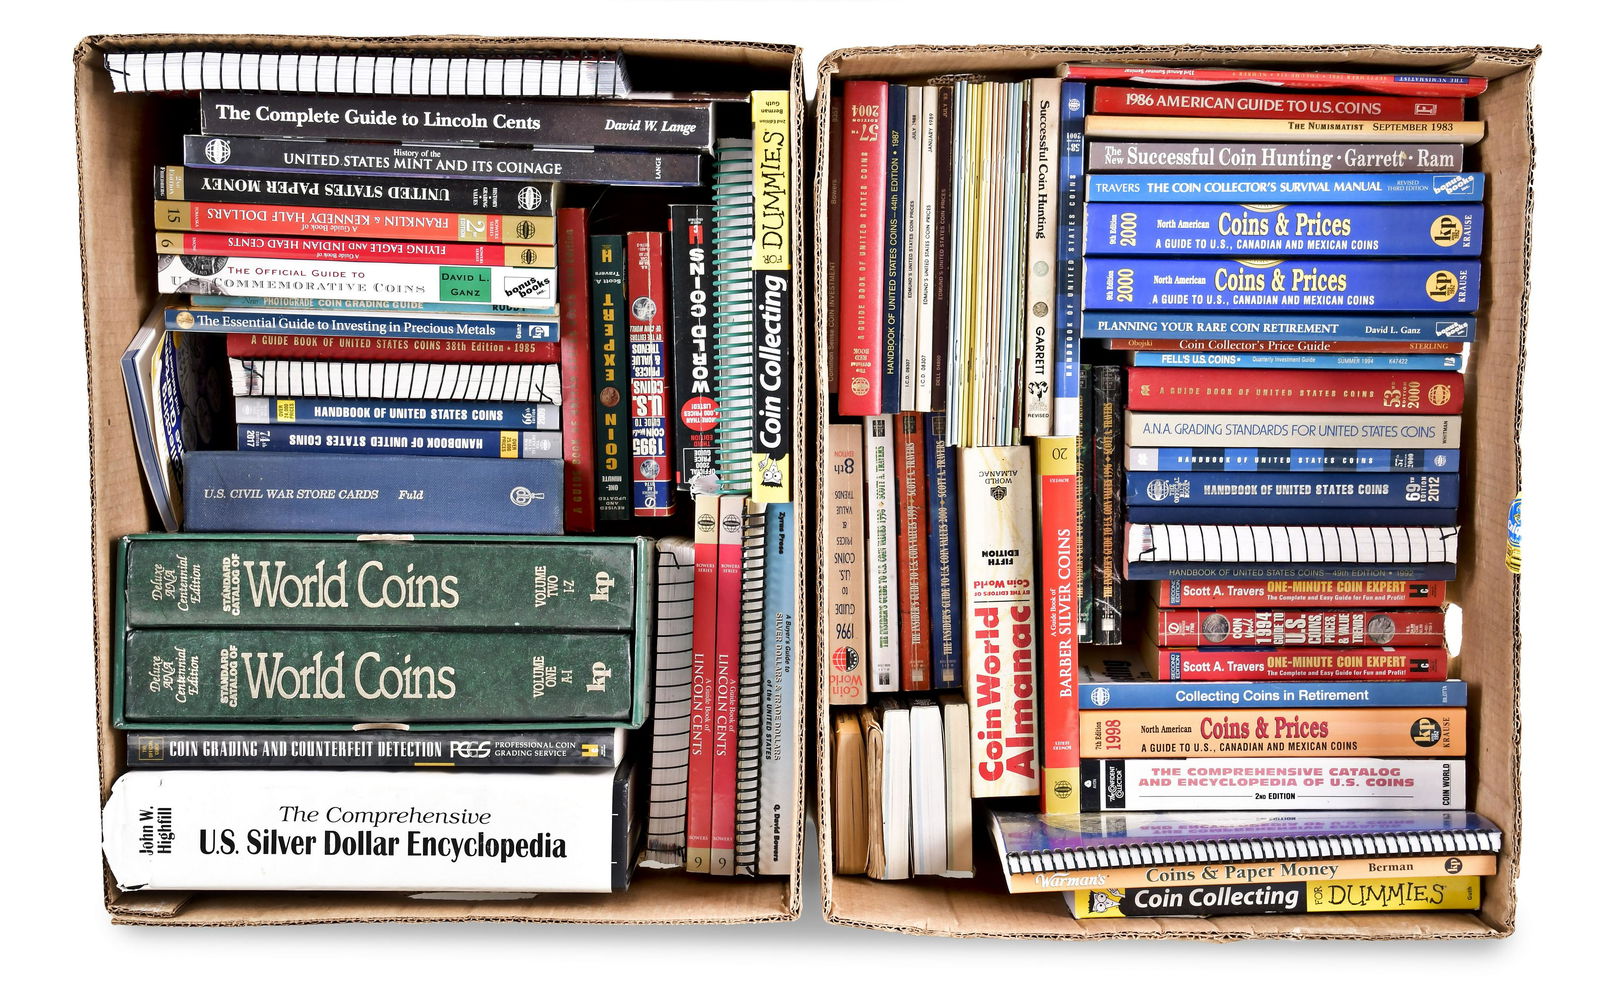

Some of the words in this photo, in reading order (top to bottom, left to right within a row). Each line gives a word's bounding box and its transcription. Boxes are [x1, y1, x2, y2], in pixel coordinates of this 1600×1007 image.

[1126, 93, 1154, 106] 1986
[1157, 95, 1234, 110] AMERICAN
[1237, 96, 1284, 112] GUIDE
[1287, 100, 1308, 112] TO
[216, 104, 251, 120] The
[256, 105, 340, 127] Complete
[344, 109, 397, 126] Guide
[402, 113, 419, 126] to
[424, 112, 488, 128] Lincoln
[494, 114, 540, 130] Cents
[604, 119, 641, 132] David
[644, 121, 658, 132] W.
[661, 121, 696, 135] Lange
[1040, 100, 1050, 160] Successful
[284, 152, 340, 166] UNITED
[344, 155, 390, 169] STATES
[394, 157, 432, 170] MINT
[436, 160, 468, 172] AND
[472, 161, 492, 172] ITS
[496, 162, 562, 174] COINAGE
[394, 148, 419, 159] History
[420, 149, 428, 158] of
[430, 150, 440, 158] the
[1127, 146, 1214, 166] Successful
[1219, 148, 1256, 166] Coin
[1261, 148, 1334, 170] Hunting
[1344, 149, 1405, 167] Garrett
[1417, 149, 1454, 167] Ram
[202, 177, 261, 192] MONEY
[266, 180, 320, 196] PAPER
[1038, 164, 1048, 191] Coin
[325, 184, 383, 198] STATES
[388, 186, 450, 201] UNITED
[760, 131, 786, 250] DUMMIES
[1036, 194, 1048, 239] Hunting
[1218, 212, 1269, 236] Coins
[1274, 212, 1290, 236] &
[1295, 212, 1352, 236] Prices
[1155, 240, 1161, 248] A
[1164, 240, 1192, 249] GUIDE
[1195, 240, 1206, 249] TO
[1210, 240, 1233, 250] U.S.,
[1236, 240, 1282, 250] CANADIAN
[1285, 240, 1304, 250] AND
[1307, 240, 1348, 250] MEXICAN
[1351, 240, 1379, 250] COINS
[764, 254, 782, 264] FOR
[758, 274, 788, 391] Collecting
[1098, 322, 1158, 332] PLANNING
[1161, 322, 1193, 332] YOUR
[1196, 322, 1227, 332] RARE
[1230, 322, 1260, 332] COIN
[1263, 323, 1340, 334] RETIREMENT
[1365, 326, 1388, 334] David
[1390, 326, 1398, 334] L.
[1400, 326, 1421, 334] Ganz
[1035, 326, 1046, 375] GARRETT
[1179, 340, 1205, 350] Coin
[1208, 340, 1264, 350] Collector's
[1268, 340, 1294, 351] Price
[1298, 341, 1331, 351] Guide
[1409, 342, 1449, 350] STERLING
[758, 396, 782, 448] Coin
[1143, 422, 1172, 435] A.N.A.
[1174, 424, 1223, 435] GRADING
[1225, 424, 1288, 436] STANDARDS
[1292, 424, 1316, 437] FOR
[1319, 425, 1359, 438] UNITED
[1362, 426, 1398, 438] STATES
[1400, 426, 1436, 438] COINS
[204, 489, 227, 500] U.S.
[230, 489, 264, 500] CIVIL
[266, 489, 294, 500] WAR
[296, 489, 336, 500] STORE
[338, 489, 378, 500] CARDS
[399, 490, 424, 501] Fuld
[1428, 476, 1440, 502] 2012
[1058, 528, 1071, 580] COINS
[242, 560, 348, 608] World
[358, 560, 460, 608] Coins
[534, 566, 548, 608] VOLUME
[547, 575, 559, 597] TWO
[563, 580, 575, 593] I-Z
[1183, 586, 1211, 596] Scott
[1213, 586, 1224, 596] A.
[1227, 586, 1264, 596] Travers
[1267, 581, 1333, 593] ONE-MINUTE
[1336, 581, 1363, 593] COIN
[1366, 581, 1407, 593] EXPERT
[1280, 594, 1306, 602] Complete
[1058, 584, 1072, 635] SILVER
[836, 624, 854, 640] 1996
[1256, 612, 1272, 644] 1994
[974, 608, 1001, 708] World
[1060, 638, 1072, 698] BARBER
[693, 653, 704, 714] LINCOLN
[1005, 606, 1035, 780] Almanac
[1176, 690, 1240, 704] Collecting
[1243, 690, 1280, 702] Coins
[1283, 690, 1295, 701] in
[1298, 689, 1369, 701] Retirement
[692, 714, 703, 756] CENTS
[978, 710, 1004, 782] Coin
[1105, 719, 1121, 751] 1998
[169, 740, 199, 757] COIN
[203, 740, 259, 757] GRADING
[262, 740, 287, 757] AND
[291, 740, 374, 757] COUNTERFEIT
[378, 740, 442, 757] DETECTION
[1138, 778, 1172, 787] AND
[1178, 778, 1298, 787] ENCYCLOPEDIA
[1303, 778, 1324, 787] OF
[1330, 778, 1360, 787] U.S.
[1366, 778, 1414, 787] COINS
[1152, 768, 1181, 776] THE
[1187, 768, 1323, 776] COMPREHENSIVE
[1328, 768, 1401, 776] CATALOG
[138, 806, 154, 822] W.
[279, 806, 319, 823] The
[326, 806, 492, 828] Comprehensive
[138, 825, 154, 856] John
[157, 808, 176, 854] Highfill
[200, 828, 240, 855] U.S.
[247, 828, 316, 855] Silver
[324, 830, 400, 856] Dollar
[408, 830, 568, 863] Encyclopedia
[1146, 867, 1196, 882] Coins
[1202, 866, 1219, 880] &
[1225, 864, 1275, 882] Paper
[1280, 863, 1338, 880] Money
[1368, 862, 1414, 872] Berman
